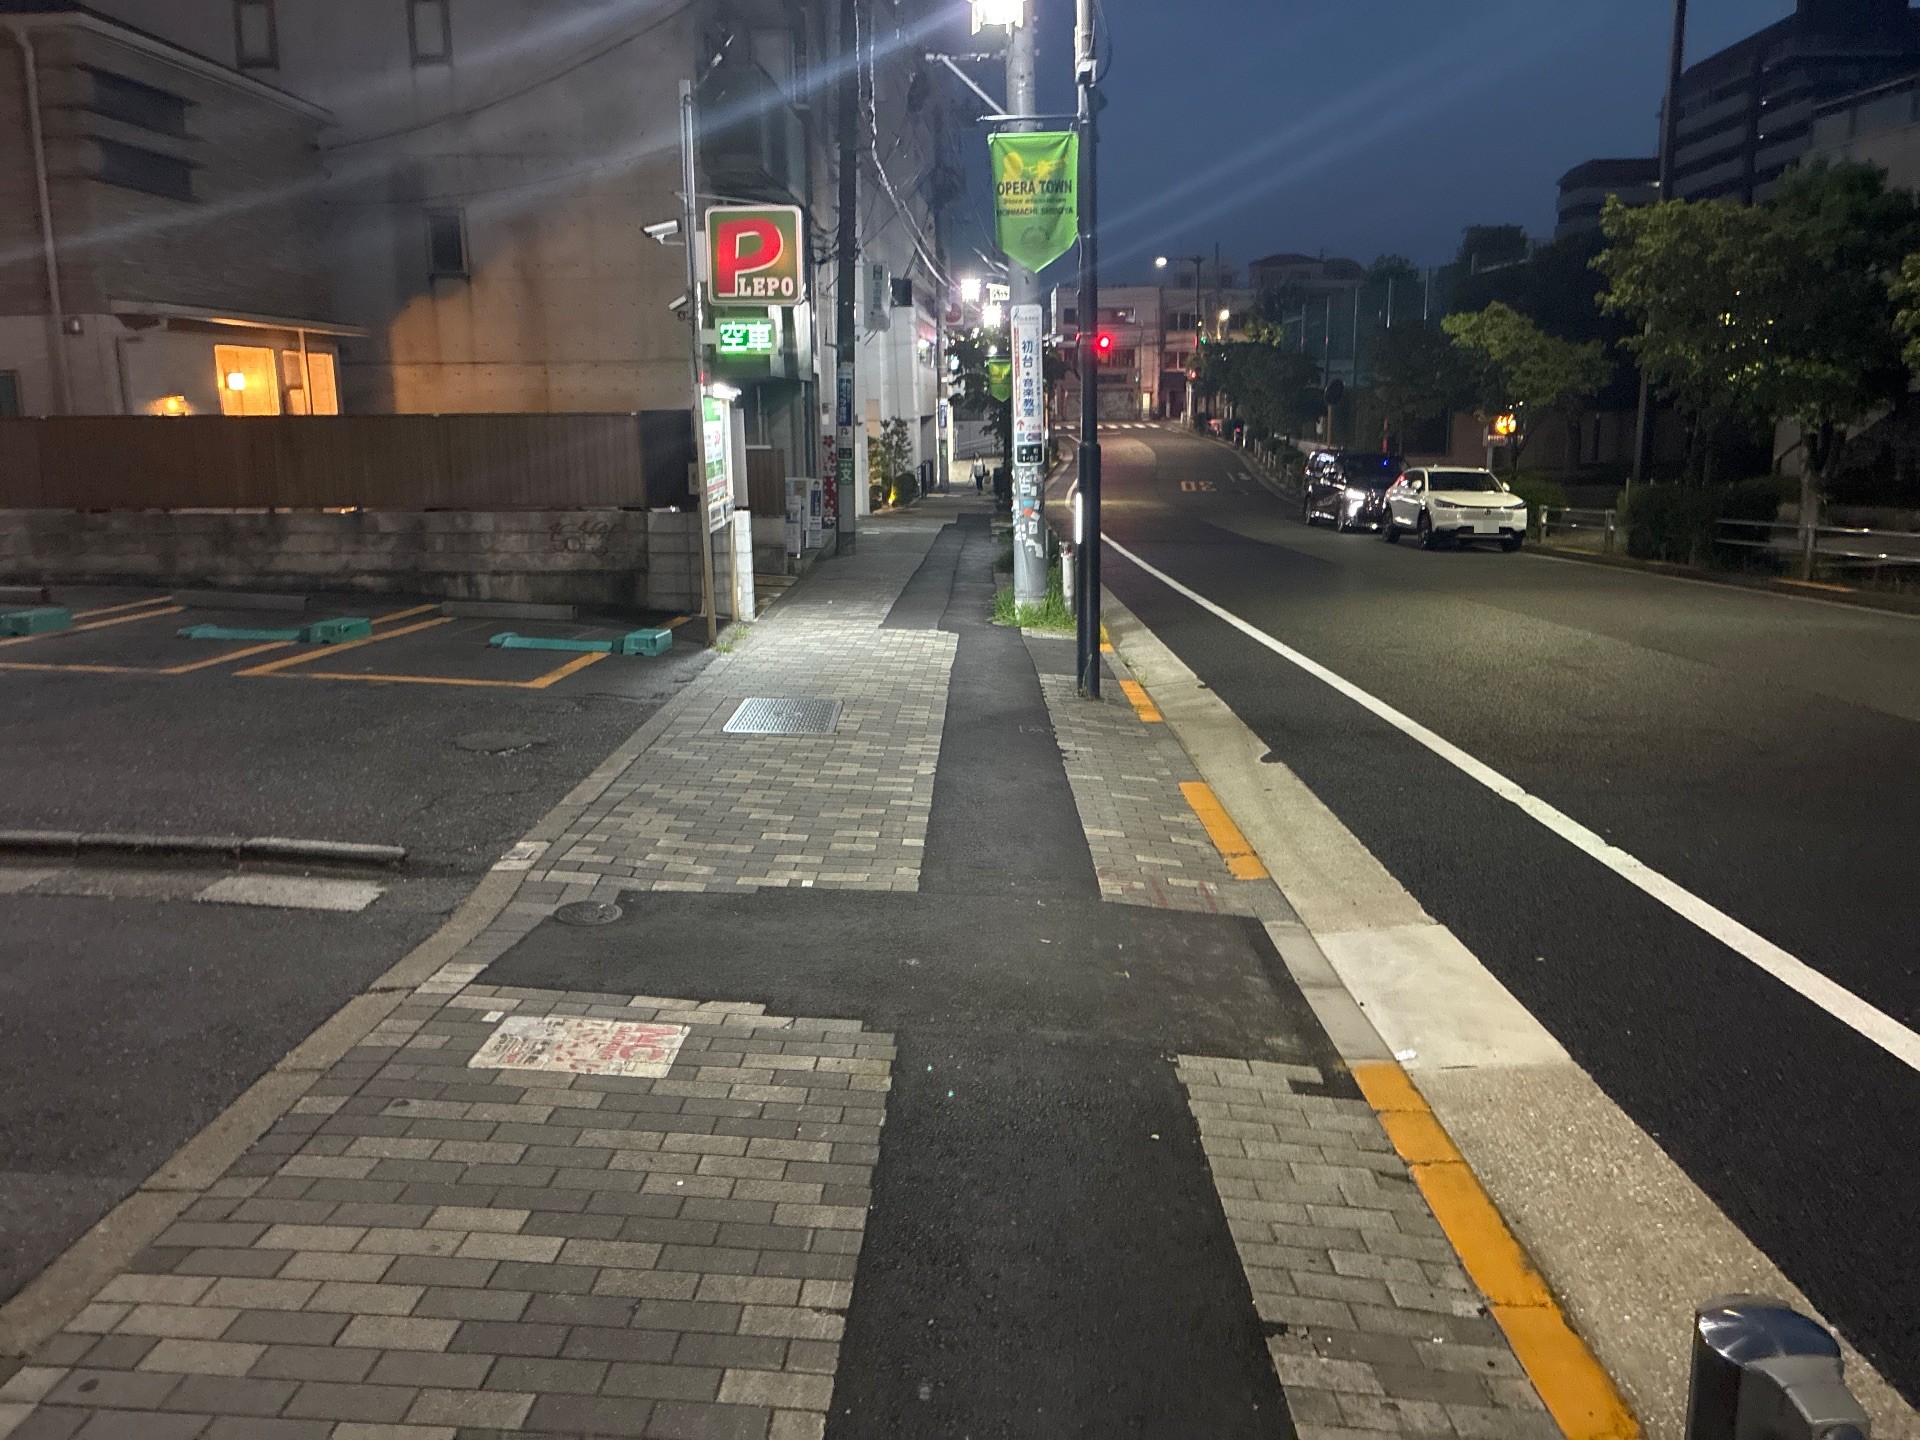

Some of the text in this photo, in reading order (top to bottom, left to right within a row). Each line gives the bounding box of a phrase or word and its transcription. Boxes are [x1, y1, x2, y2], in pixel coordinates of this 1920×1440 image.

[997, 179, 1073, 197] OPERA TOWN
[738, 276, 795, 297] LEPO
[720, 320, 773, 352] 空車
